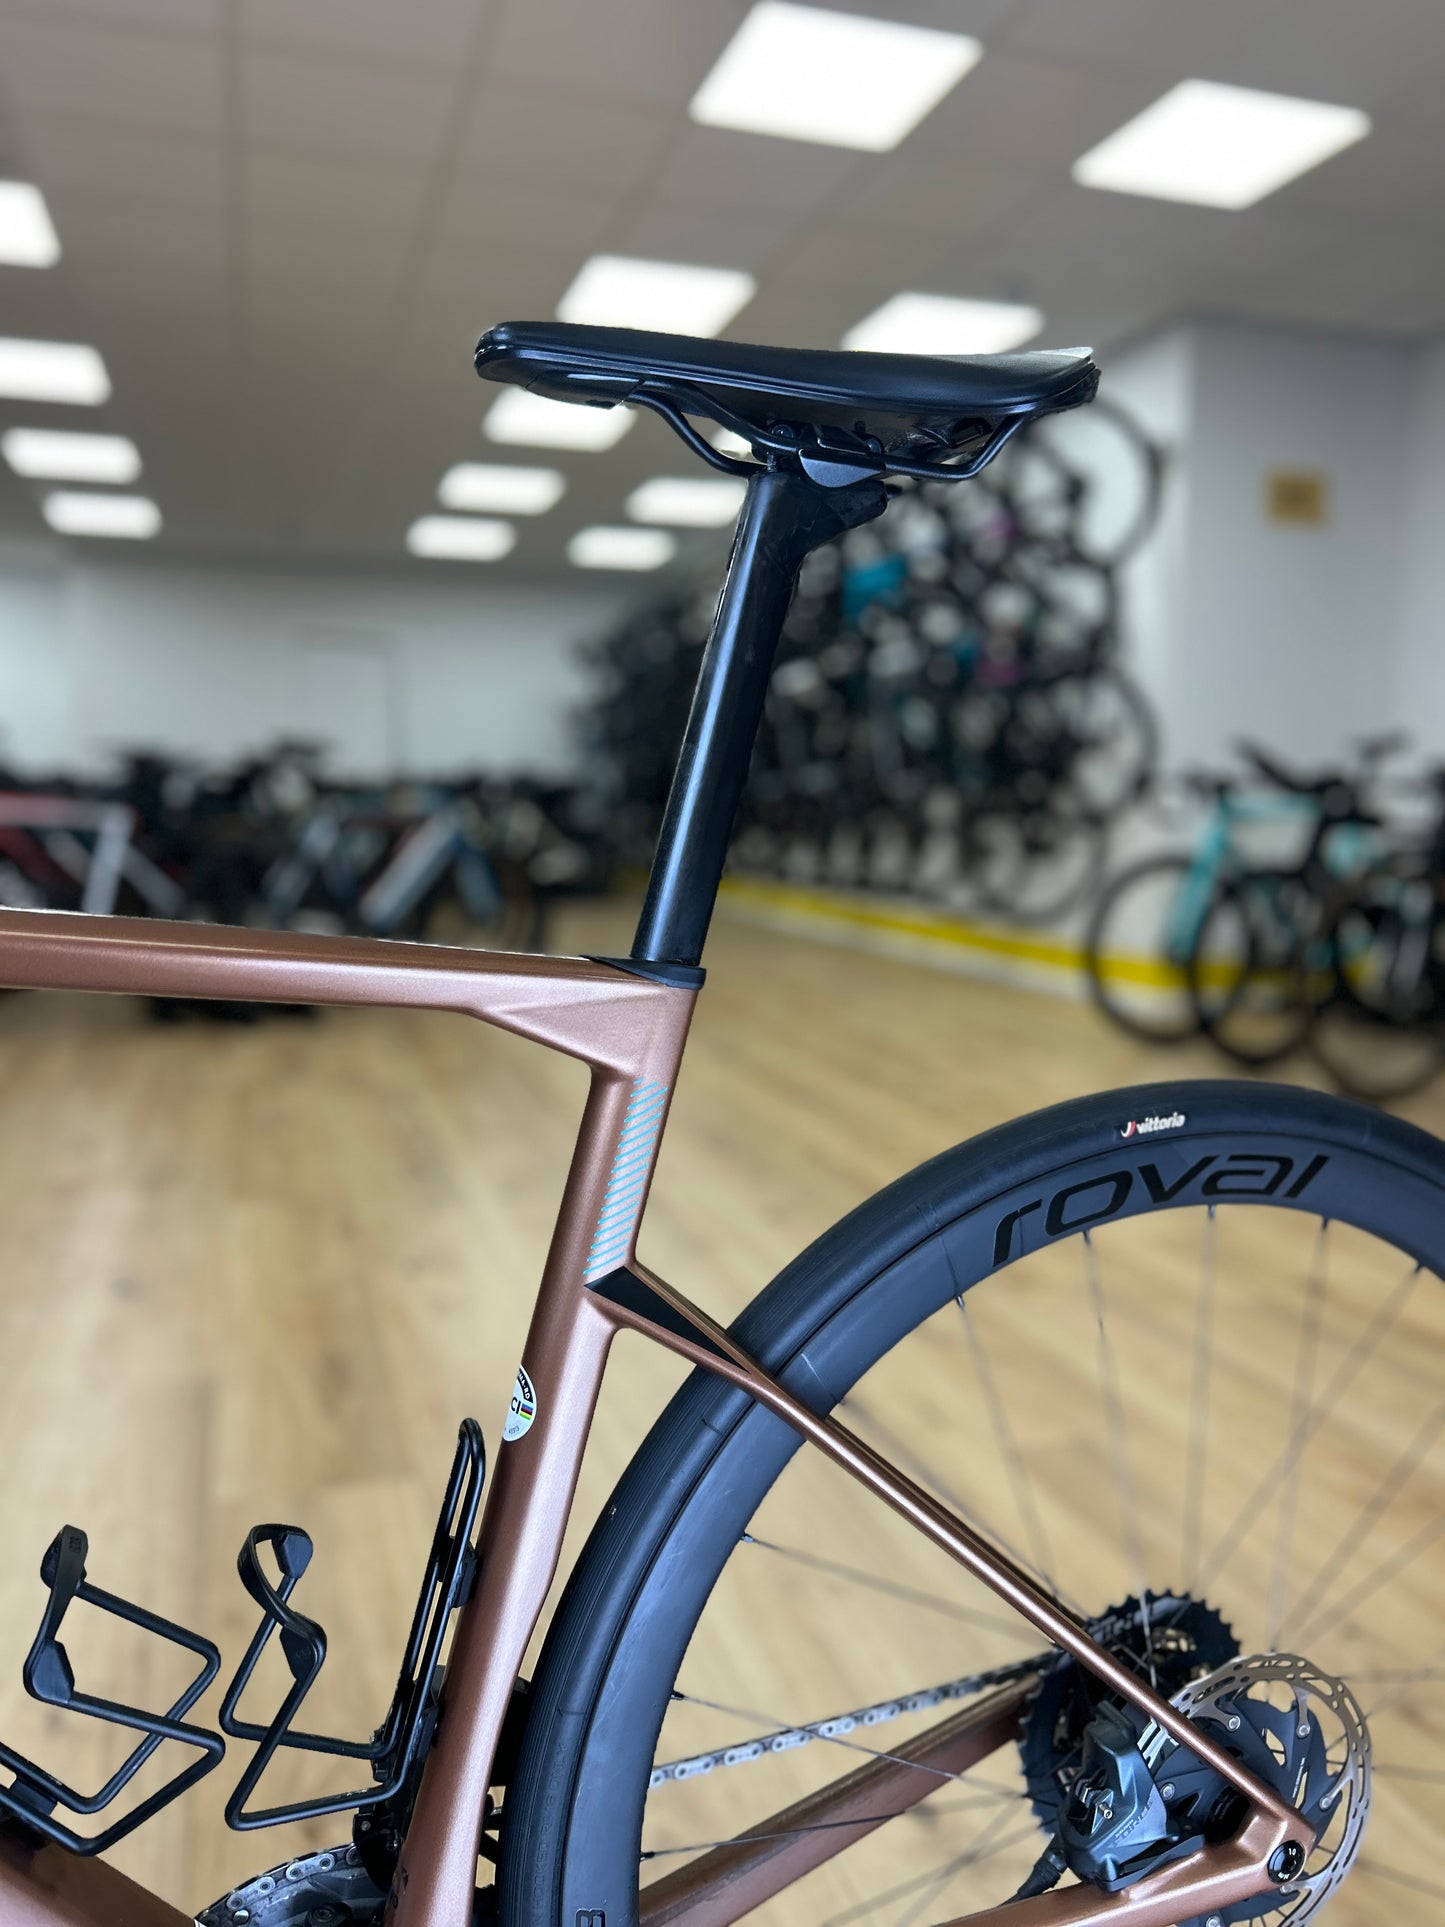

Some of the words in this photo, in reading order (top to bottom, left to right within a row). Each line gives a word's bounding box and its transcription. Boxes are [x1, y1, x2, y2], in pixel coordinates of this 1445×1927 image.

[1136, 1112, 1185, 1134] vittoria
[993, 1154, 1330, 1267] roval
[1288, 1847, 1297, 1856] 10
